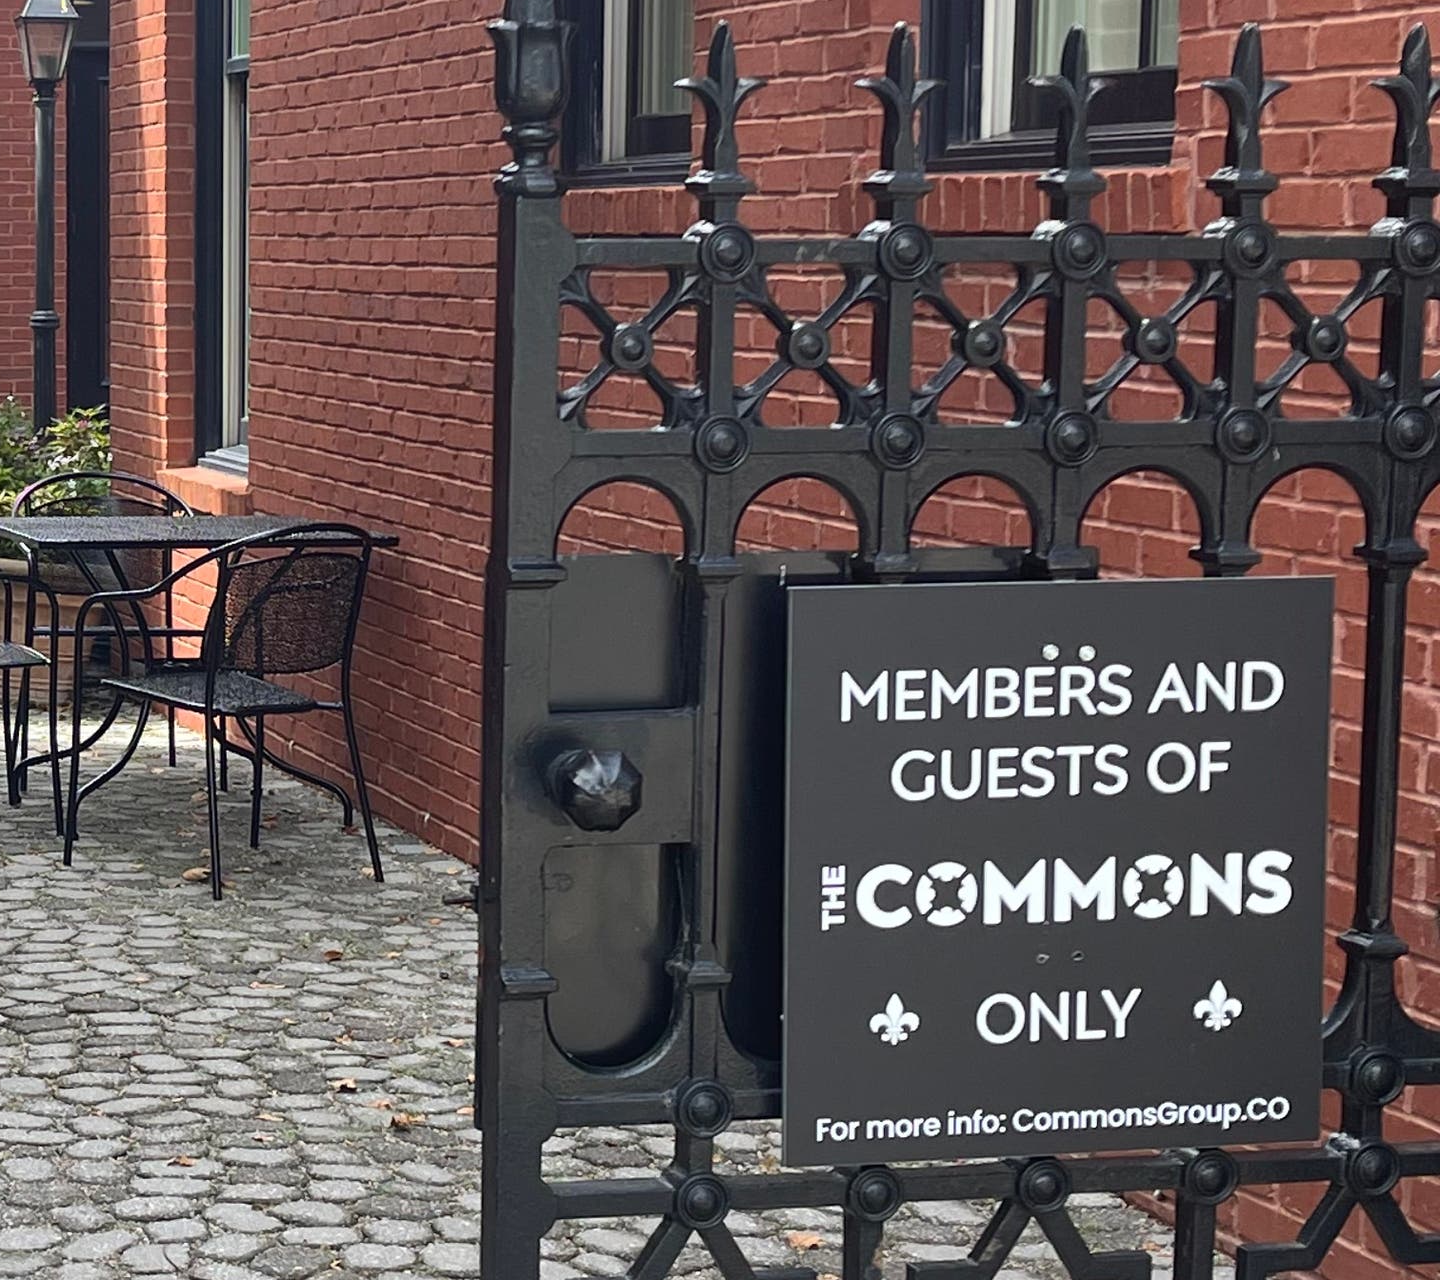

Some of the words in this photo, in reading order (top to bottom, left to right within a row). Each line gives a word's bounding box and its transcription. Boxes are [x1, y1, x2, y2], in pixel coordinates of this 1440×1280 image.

[840, 664, 1133, 722] MEMBERS
[1147, 660, 1285, 715] AND
[890, 744, 1129, 802] GUESTS
[1146, 740, 1232, 794] OF
[821, 864, 847, 931] THE
[855, 849, 1293, 929] COMMONS
[975, 987, 1142, 1045] ONLY
[816, 1117, 861, 1142] For
[865, 1116, 942, 1140] more
[947, 1108, 1007, 1137] info:
[1012, 1096, 1290, 1133] CommonsGroup.CO
